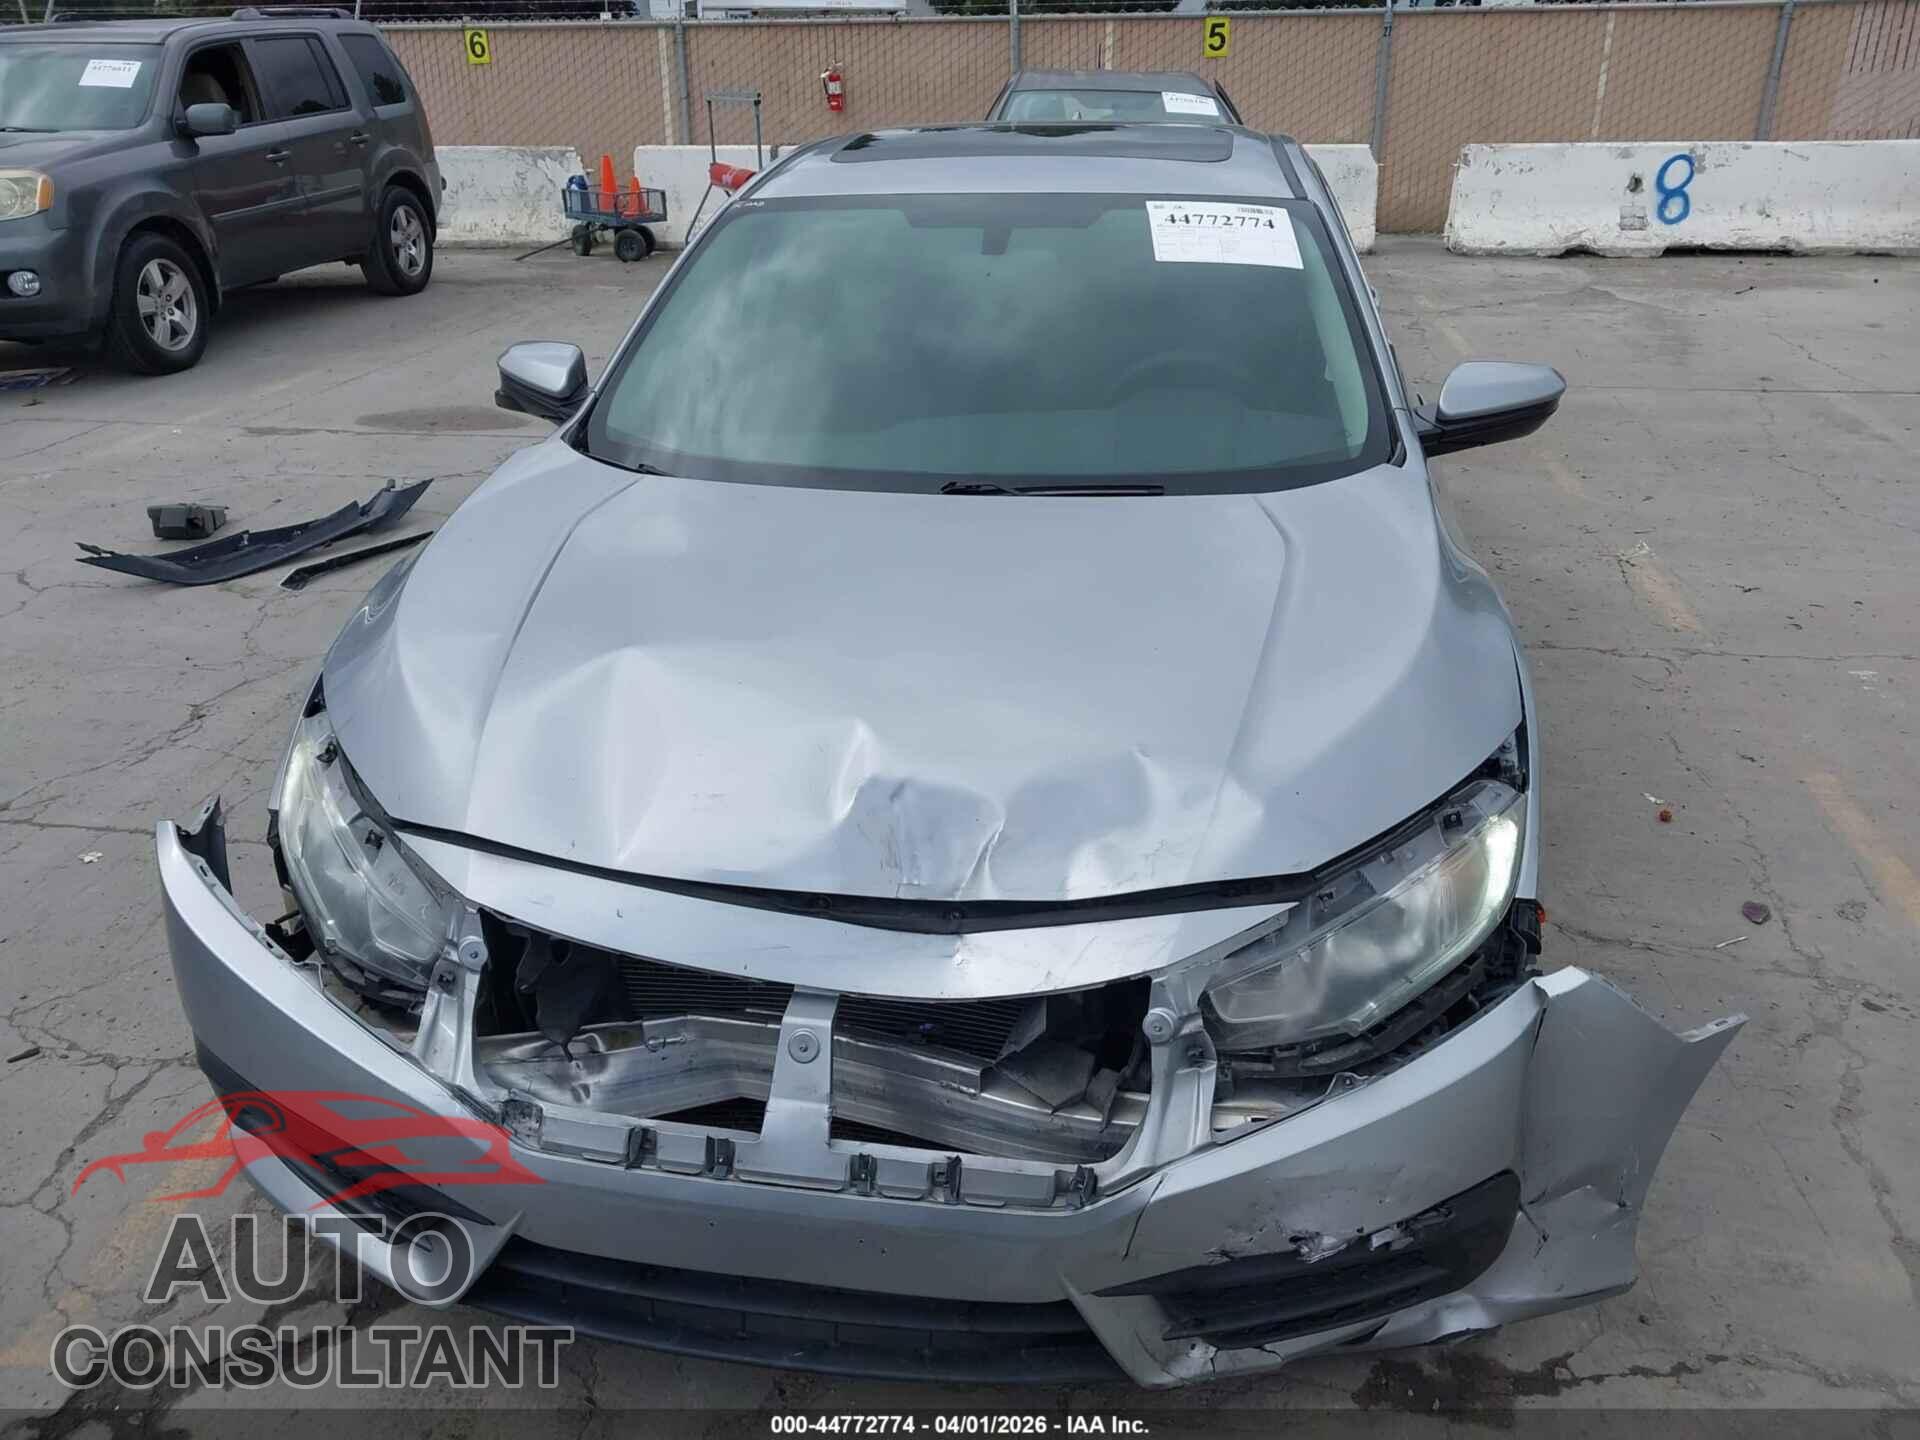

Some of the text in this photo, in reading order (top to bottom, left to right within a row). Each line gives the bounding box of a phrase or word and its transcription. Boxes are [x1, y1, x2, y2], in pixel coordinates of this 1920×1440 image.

[469, 31, 486, 58] 6
[1208, 22, 1226, 52] 5
[1656, 153, 1695, 225] 8
[1164, 213, 1276, 230] 44772774
